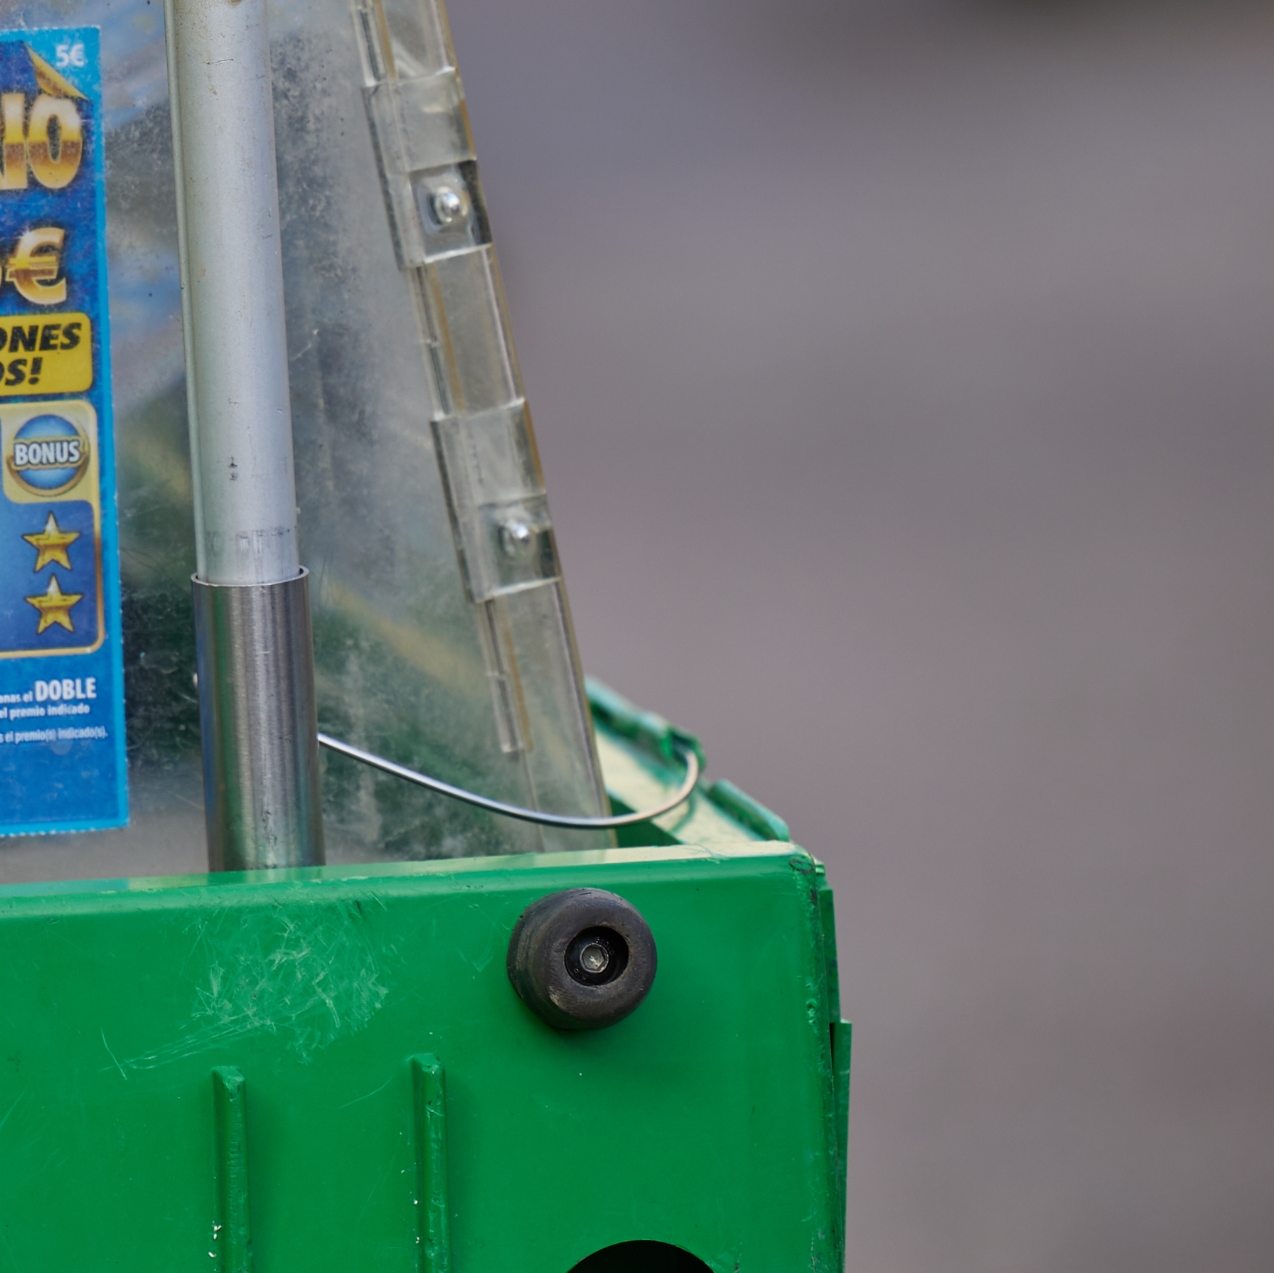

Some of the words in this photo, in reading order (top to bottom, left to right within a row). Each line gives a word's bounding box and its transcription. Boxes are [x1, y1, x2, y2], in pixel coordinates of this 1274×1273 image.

[55, 44, 85, 67] 5€
[13, 438, 80, 468] BONUS
[23, 691, 33, 702] el
[35, 678, 96, 702] DOBLE
[11, 705, 44, 721] premio
[47, 702, 90, 716] indicado
